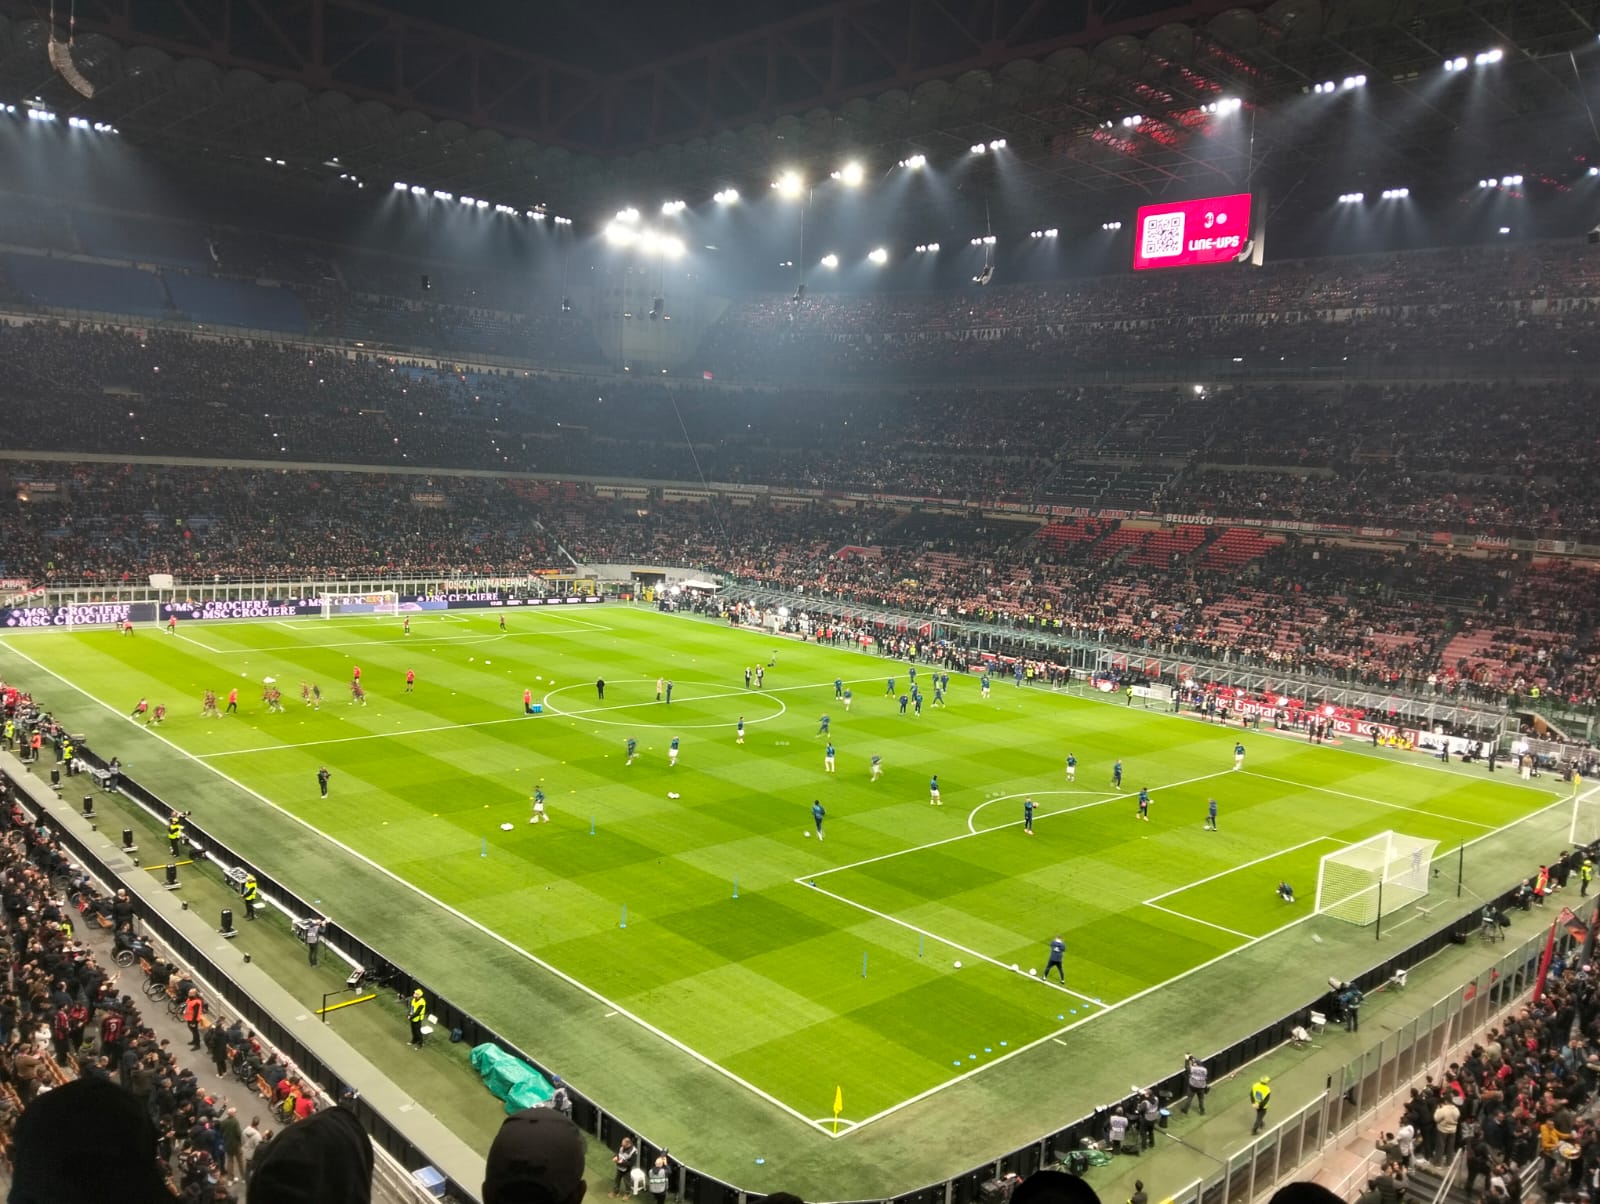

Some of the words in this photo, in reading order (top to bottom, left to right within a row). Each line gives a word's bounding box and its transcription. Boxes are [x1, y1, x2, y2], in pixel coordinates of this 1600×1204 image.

[1188, 235, 1240, 251] LINE-UPS
[1166, 513, 1213, 526] BELLUSCO
[202, 609, 230, 619] MSC
[232, 606, 296, 618] CROCIERE
[18, 615, 51, 627] MSC
